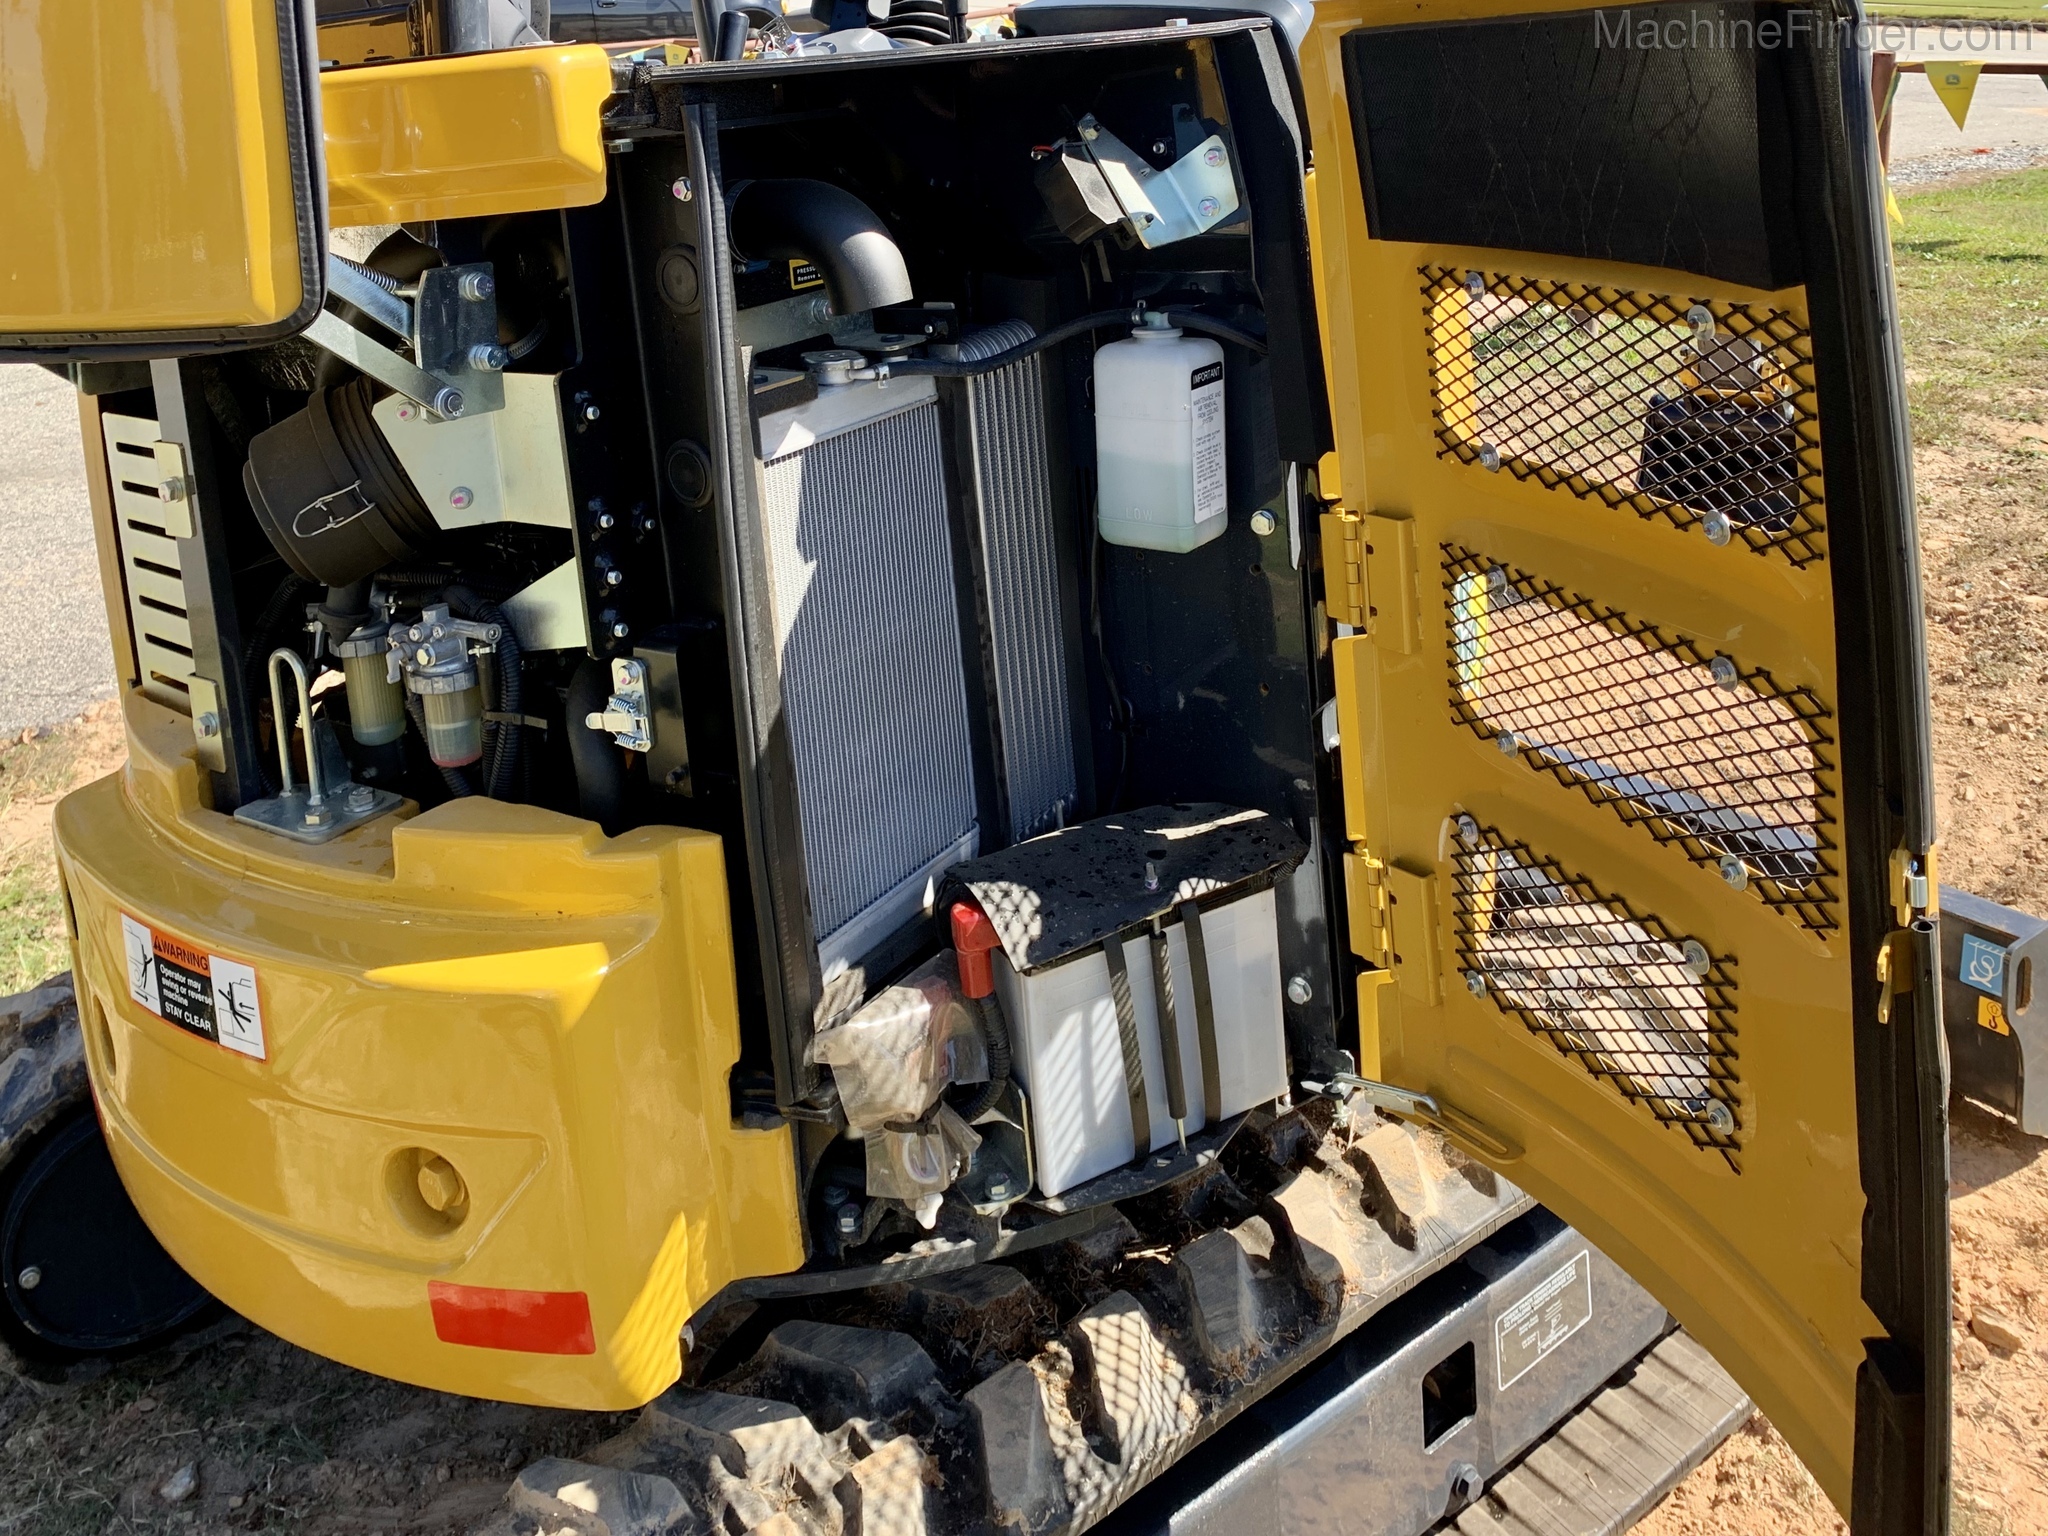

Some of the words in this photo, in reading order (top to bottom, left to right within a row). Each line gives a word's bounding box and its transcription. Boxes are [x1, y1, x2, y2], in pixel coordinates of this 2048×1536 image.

[798, 274, 816, 282] Remove
[1192, 366, 1220, 385] IMPORTANT
[1125, 507, 1152, 520] LOW
[160, 942, 208, 970] WARNING
[160, 964, 186, 984] Operator
[187, 978, 202, 992] may
[162, 976, 180, 994] swing
[180, 986, 186, 996] or
[188, 988, 213, 1006] reverse
[163, 988, 188, 1006] machine
[164, 1002, 184, 1020] STAY
[184, 1012, 212, 1032] CLEAR
[1504, 1308, 1518, 1323] CHECK
[1519, 1297, 1533, 1311] TRACK
[1533, 1282, 1551, 1299] TENSION
[1551, 1263, 1575, 1286] REGULARLY
